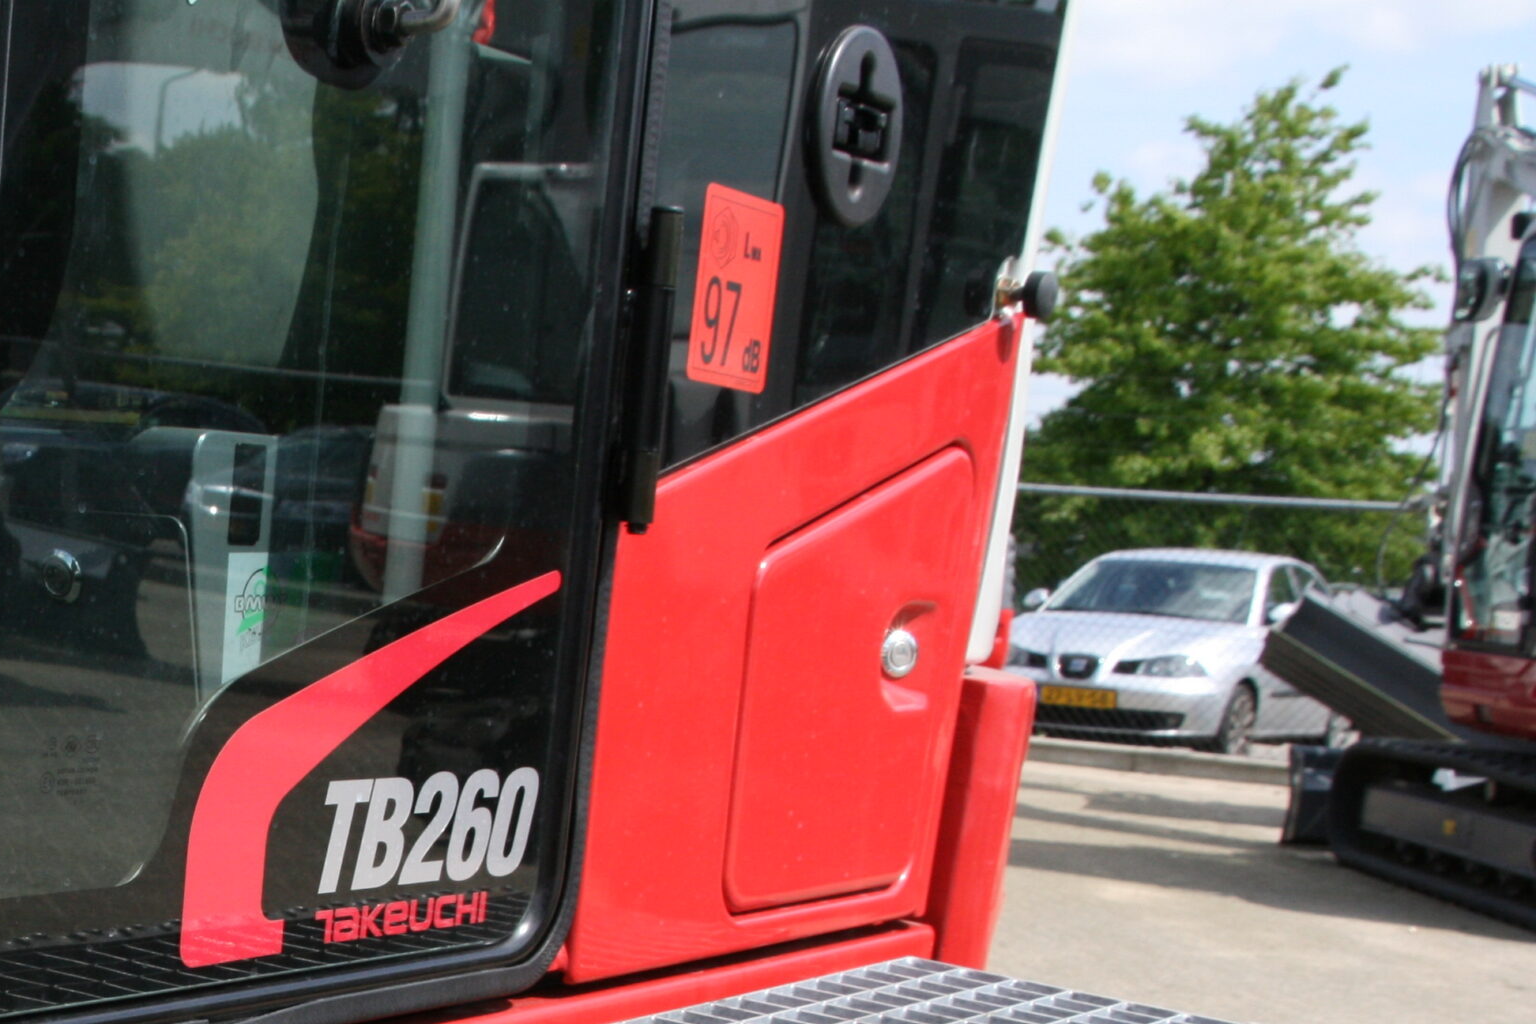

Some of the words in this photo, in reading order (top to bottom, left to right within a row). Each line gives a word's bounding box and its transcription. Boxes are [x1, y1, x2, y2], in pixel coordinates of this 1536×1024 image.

[701, 275, 742, 366] 97
[742, 338, 762, 374] dB
[318, 766, 540, 894] TB260
